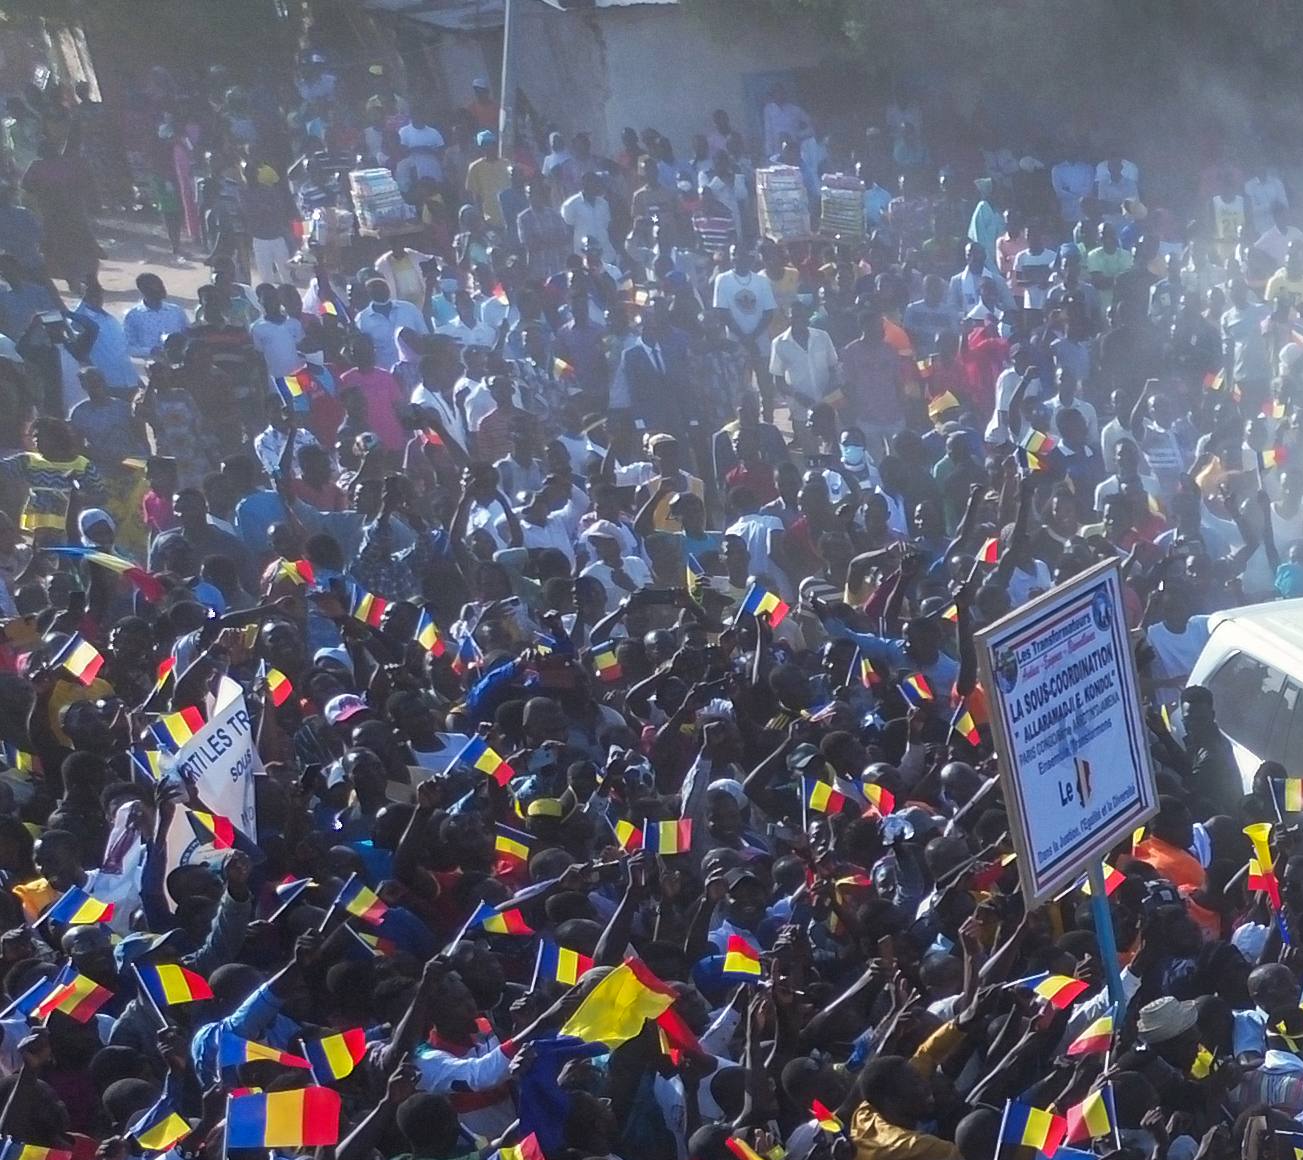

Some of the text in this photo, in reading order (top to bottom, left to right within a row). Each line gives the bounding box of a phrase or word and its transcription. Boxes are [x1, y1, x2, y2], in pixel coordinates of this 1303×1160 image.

[1015, 648, 1032, 664] Les
[1009, 698, 1024, 723] LA
[200, 727, 233, 764] LES
[1058, 781, 1074, 807] Le
